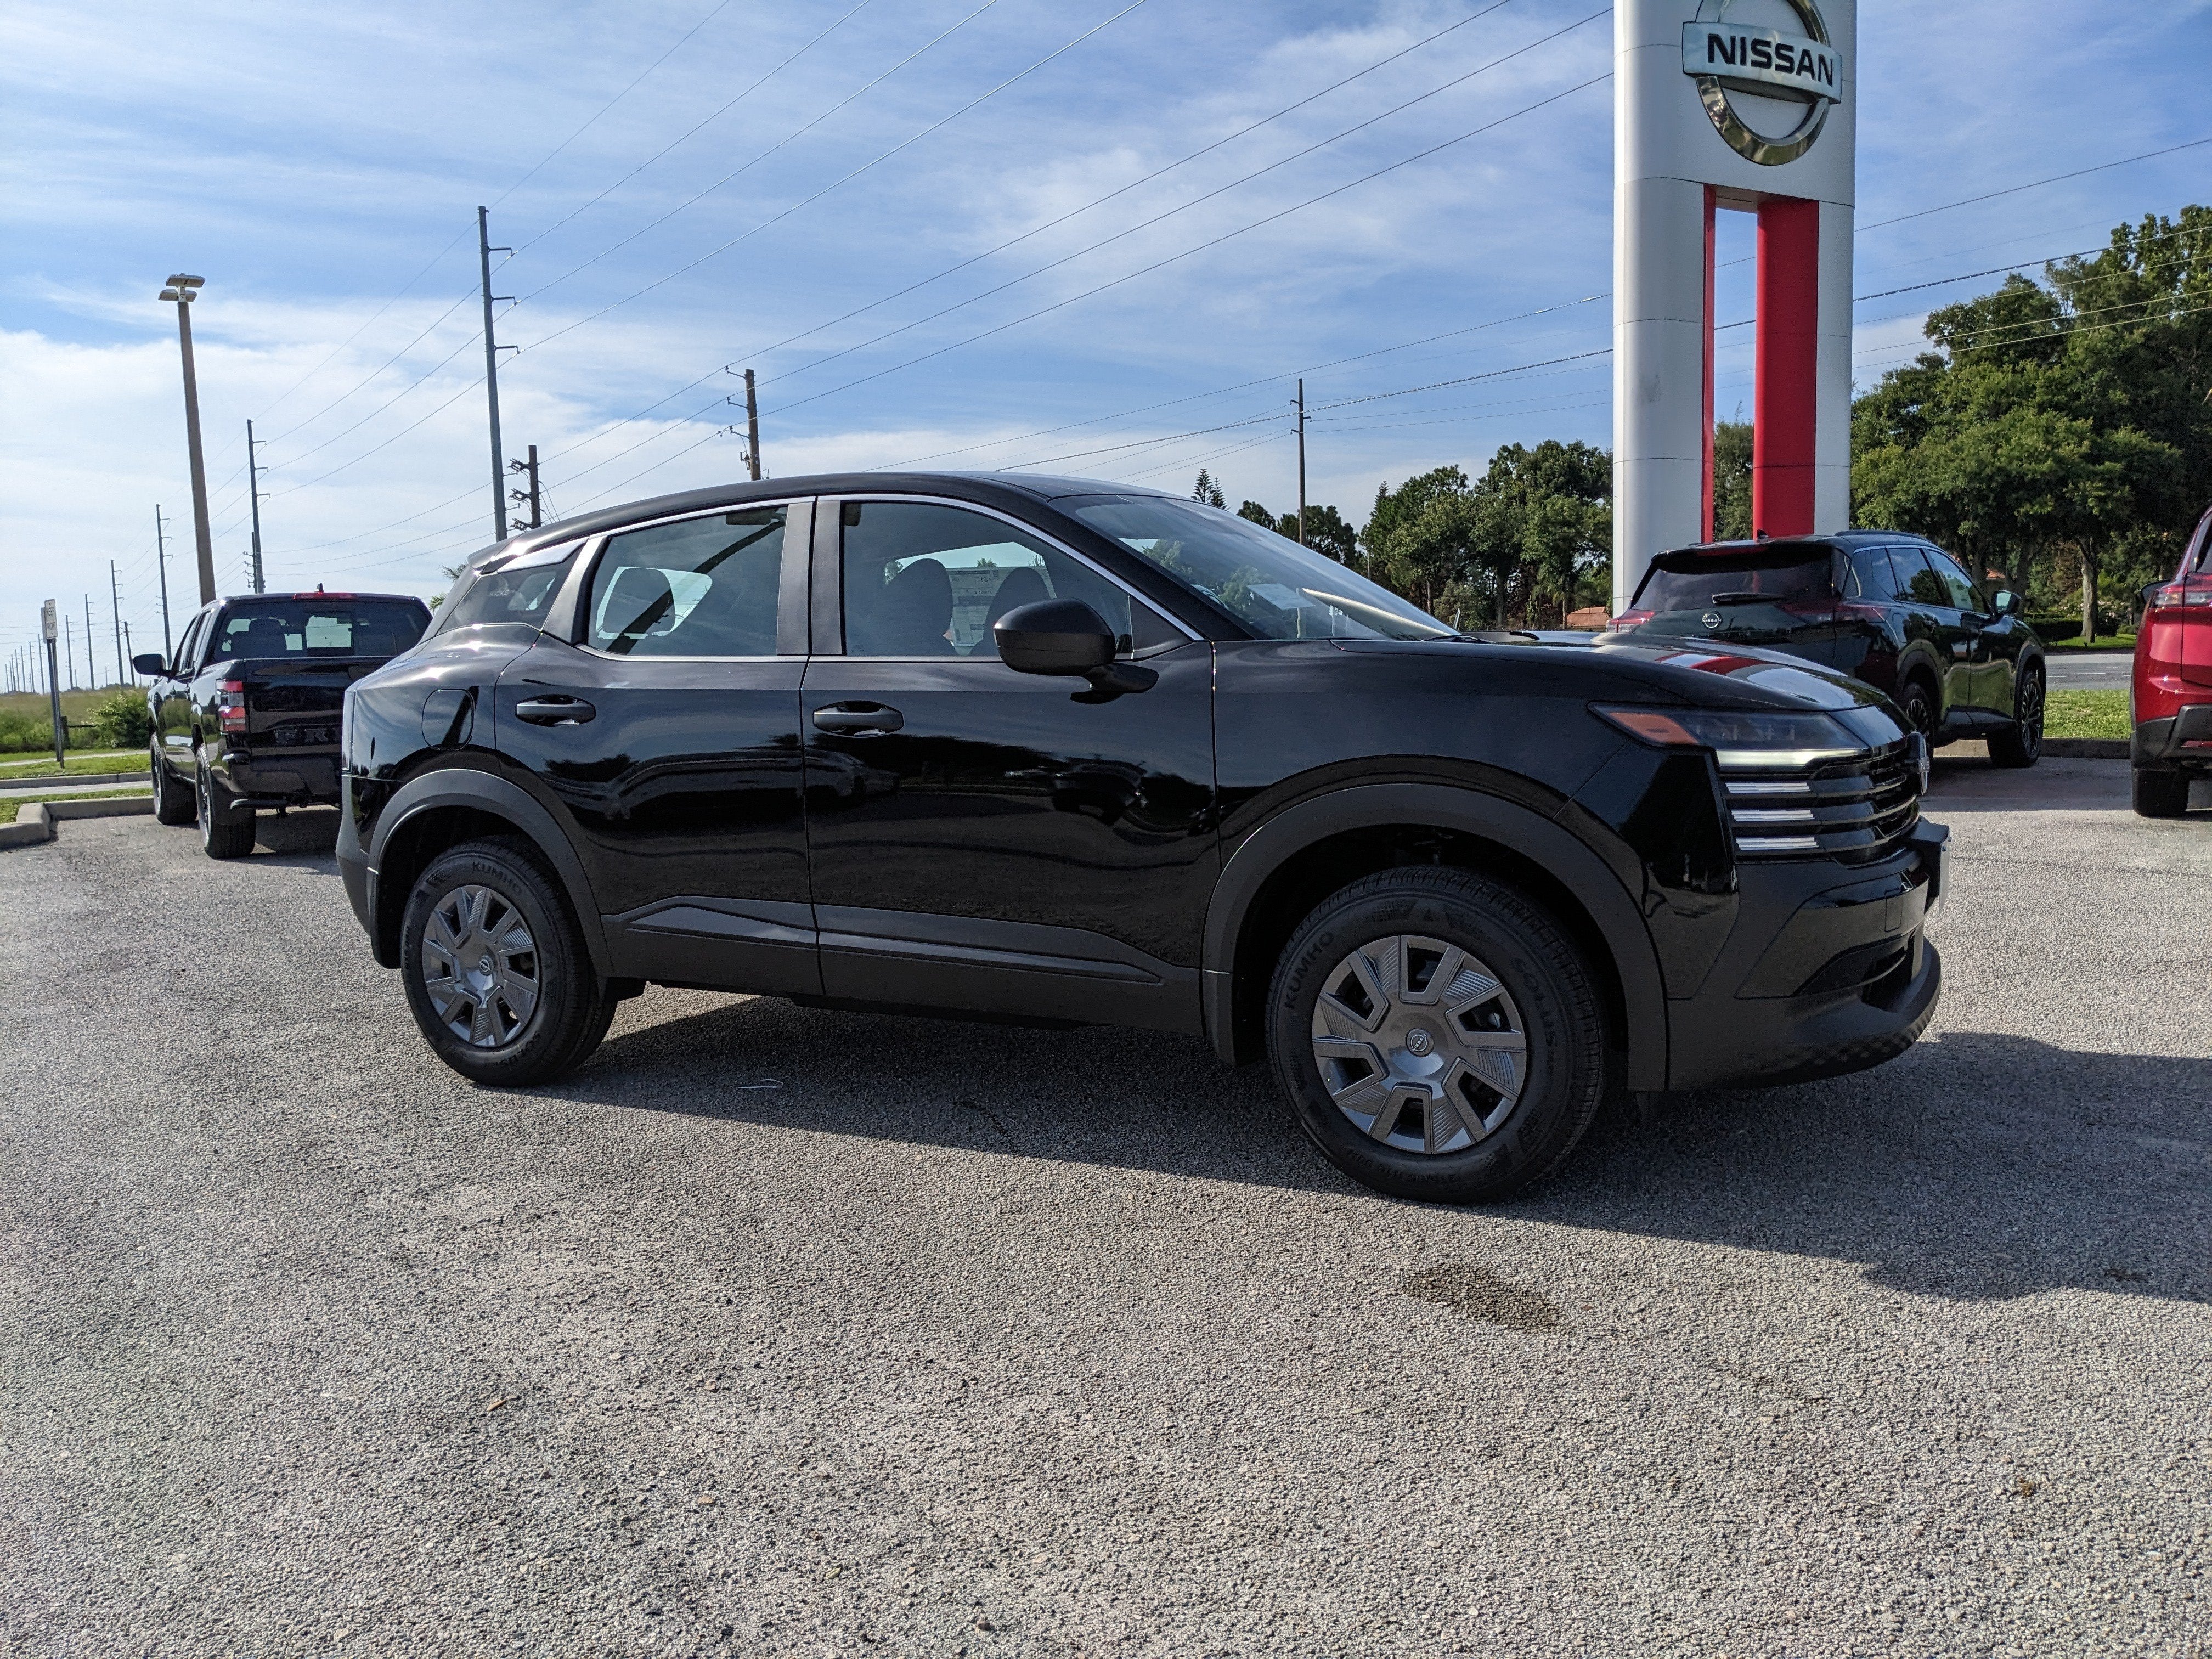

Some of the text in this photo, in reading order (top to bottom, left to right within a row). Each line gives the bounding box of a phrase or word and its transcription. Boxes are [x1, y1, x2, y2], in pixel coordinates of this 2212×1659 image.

[1707, 33, 1833, 87] NISSAN
[472, 861, 522, 894] KUMHO
[1284, 932, 1334, 1009] KUMHO
[1412, 1034, 1426, 1052] NISSAN
